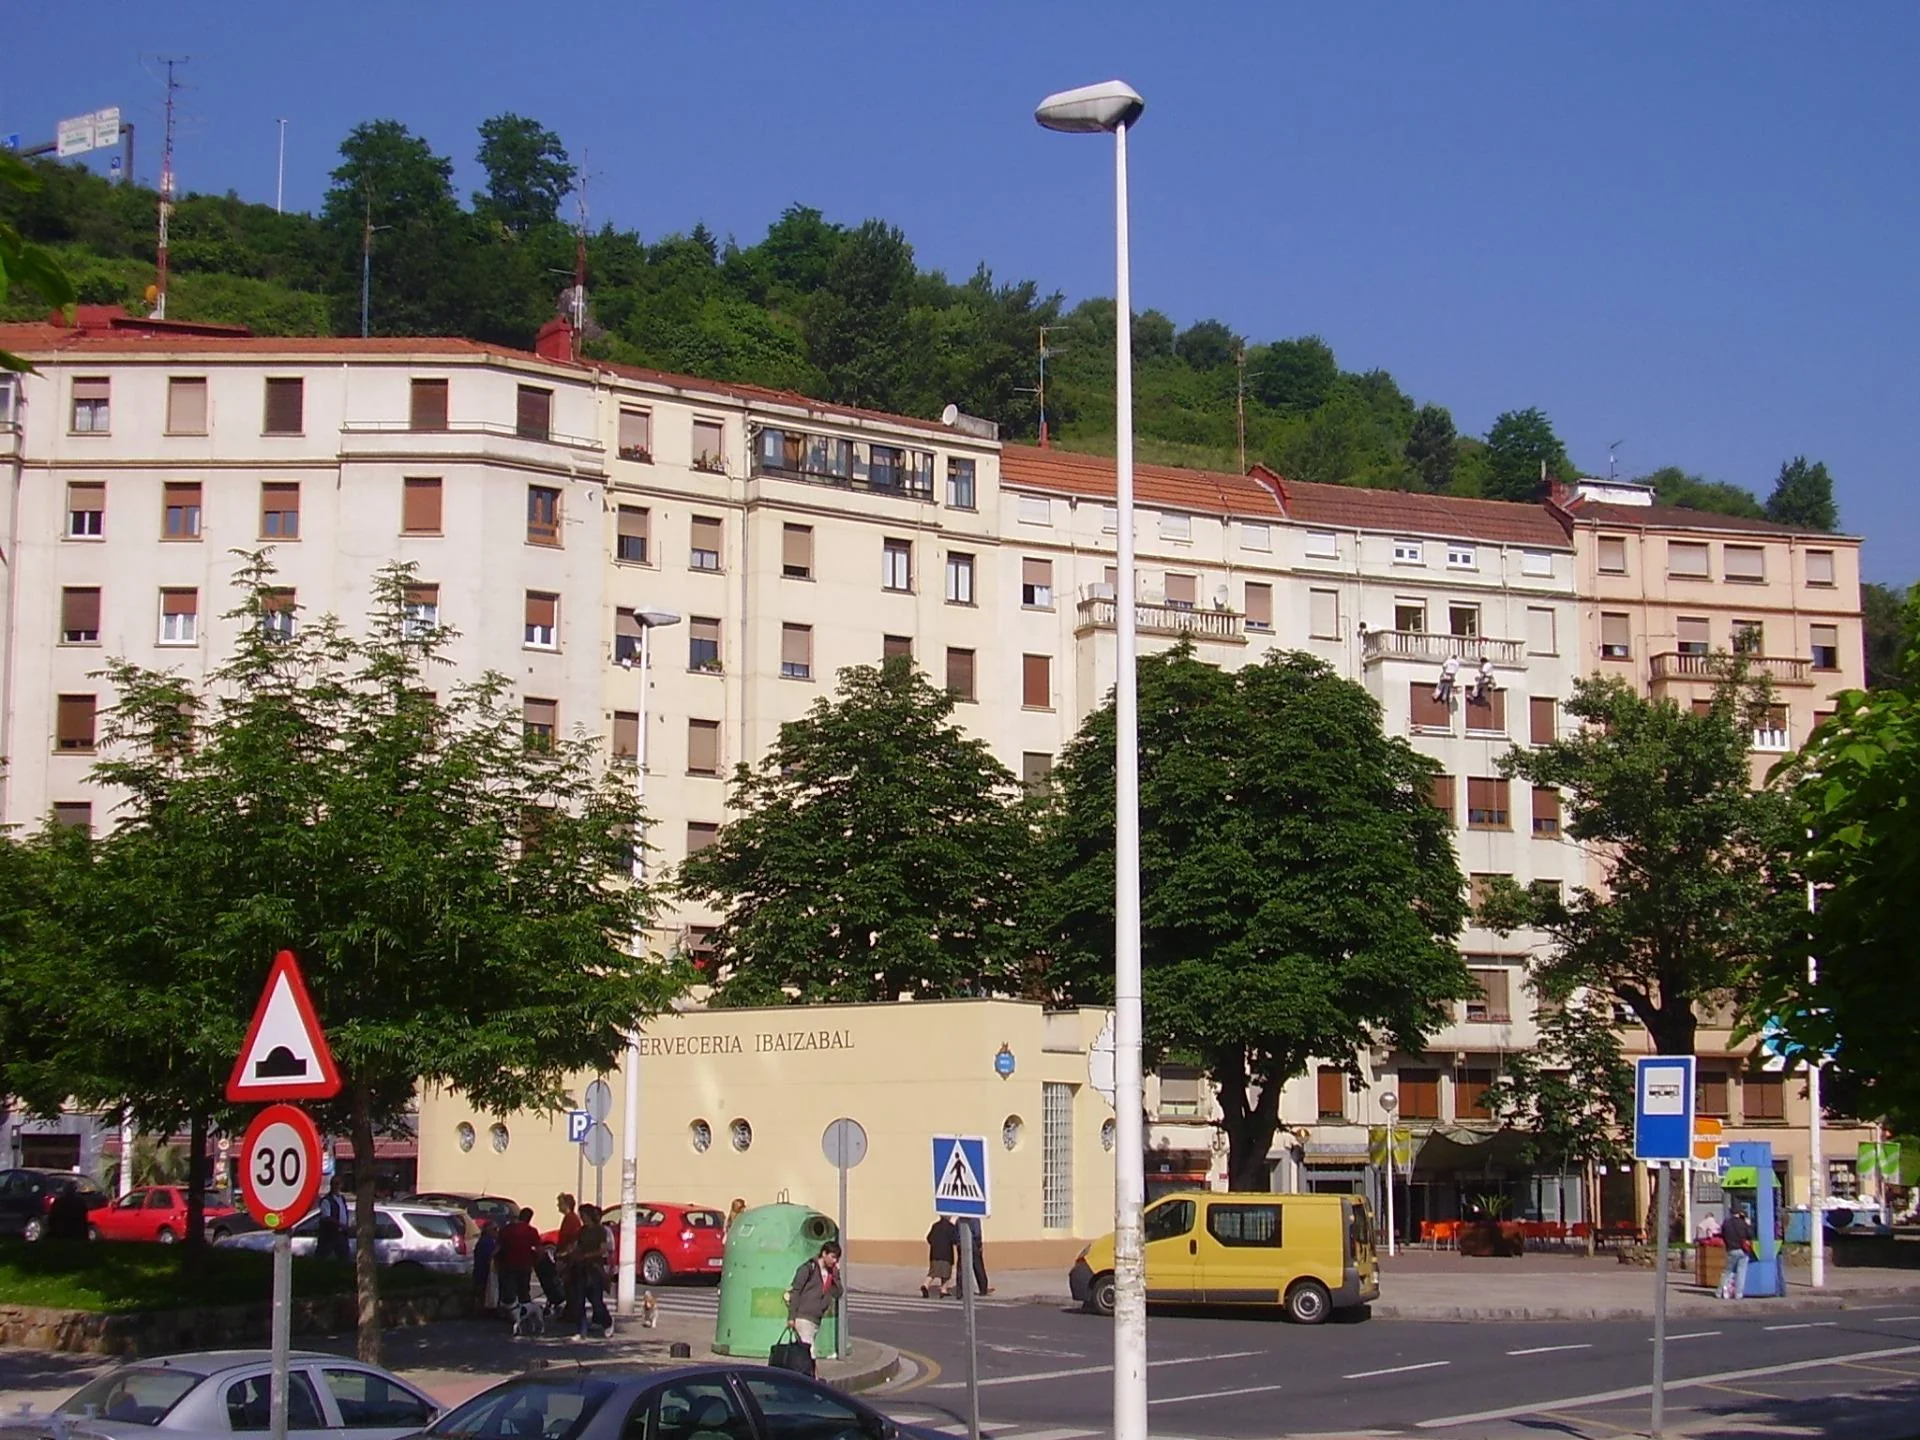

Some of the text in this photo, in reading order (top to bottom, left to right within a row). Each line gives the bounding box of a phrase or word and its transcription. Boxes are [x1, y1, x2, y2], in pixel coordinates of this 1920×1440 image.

[639, 1030, 855, 1056] ERVECERIA IBAIZABAL
[573, 1114, 587, 1139] P
[256, 1147, 300, 1187] 30
